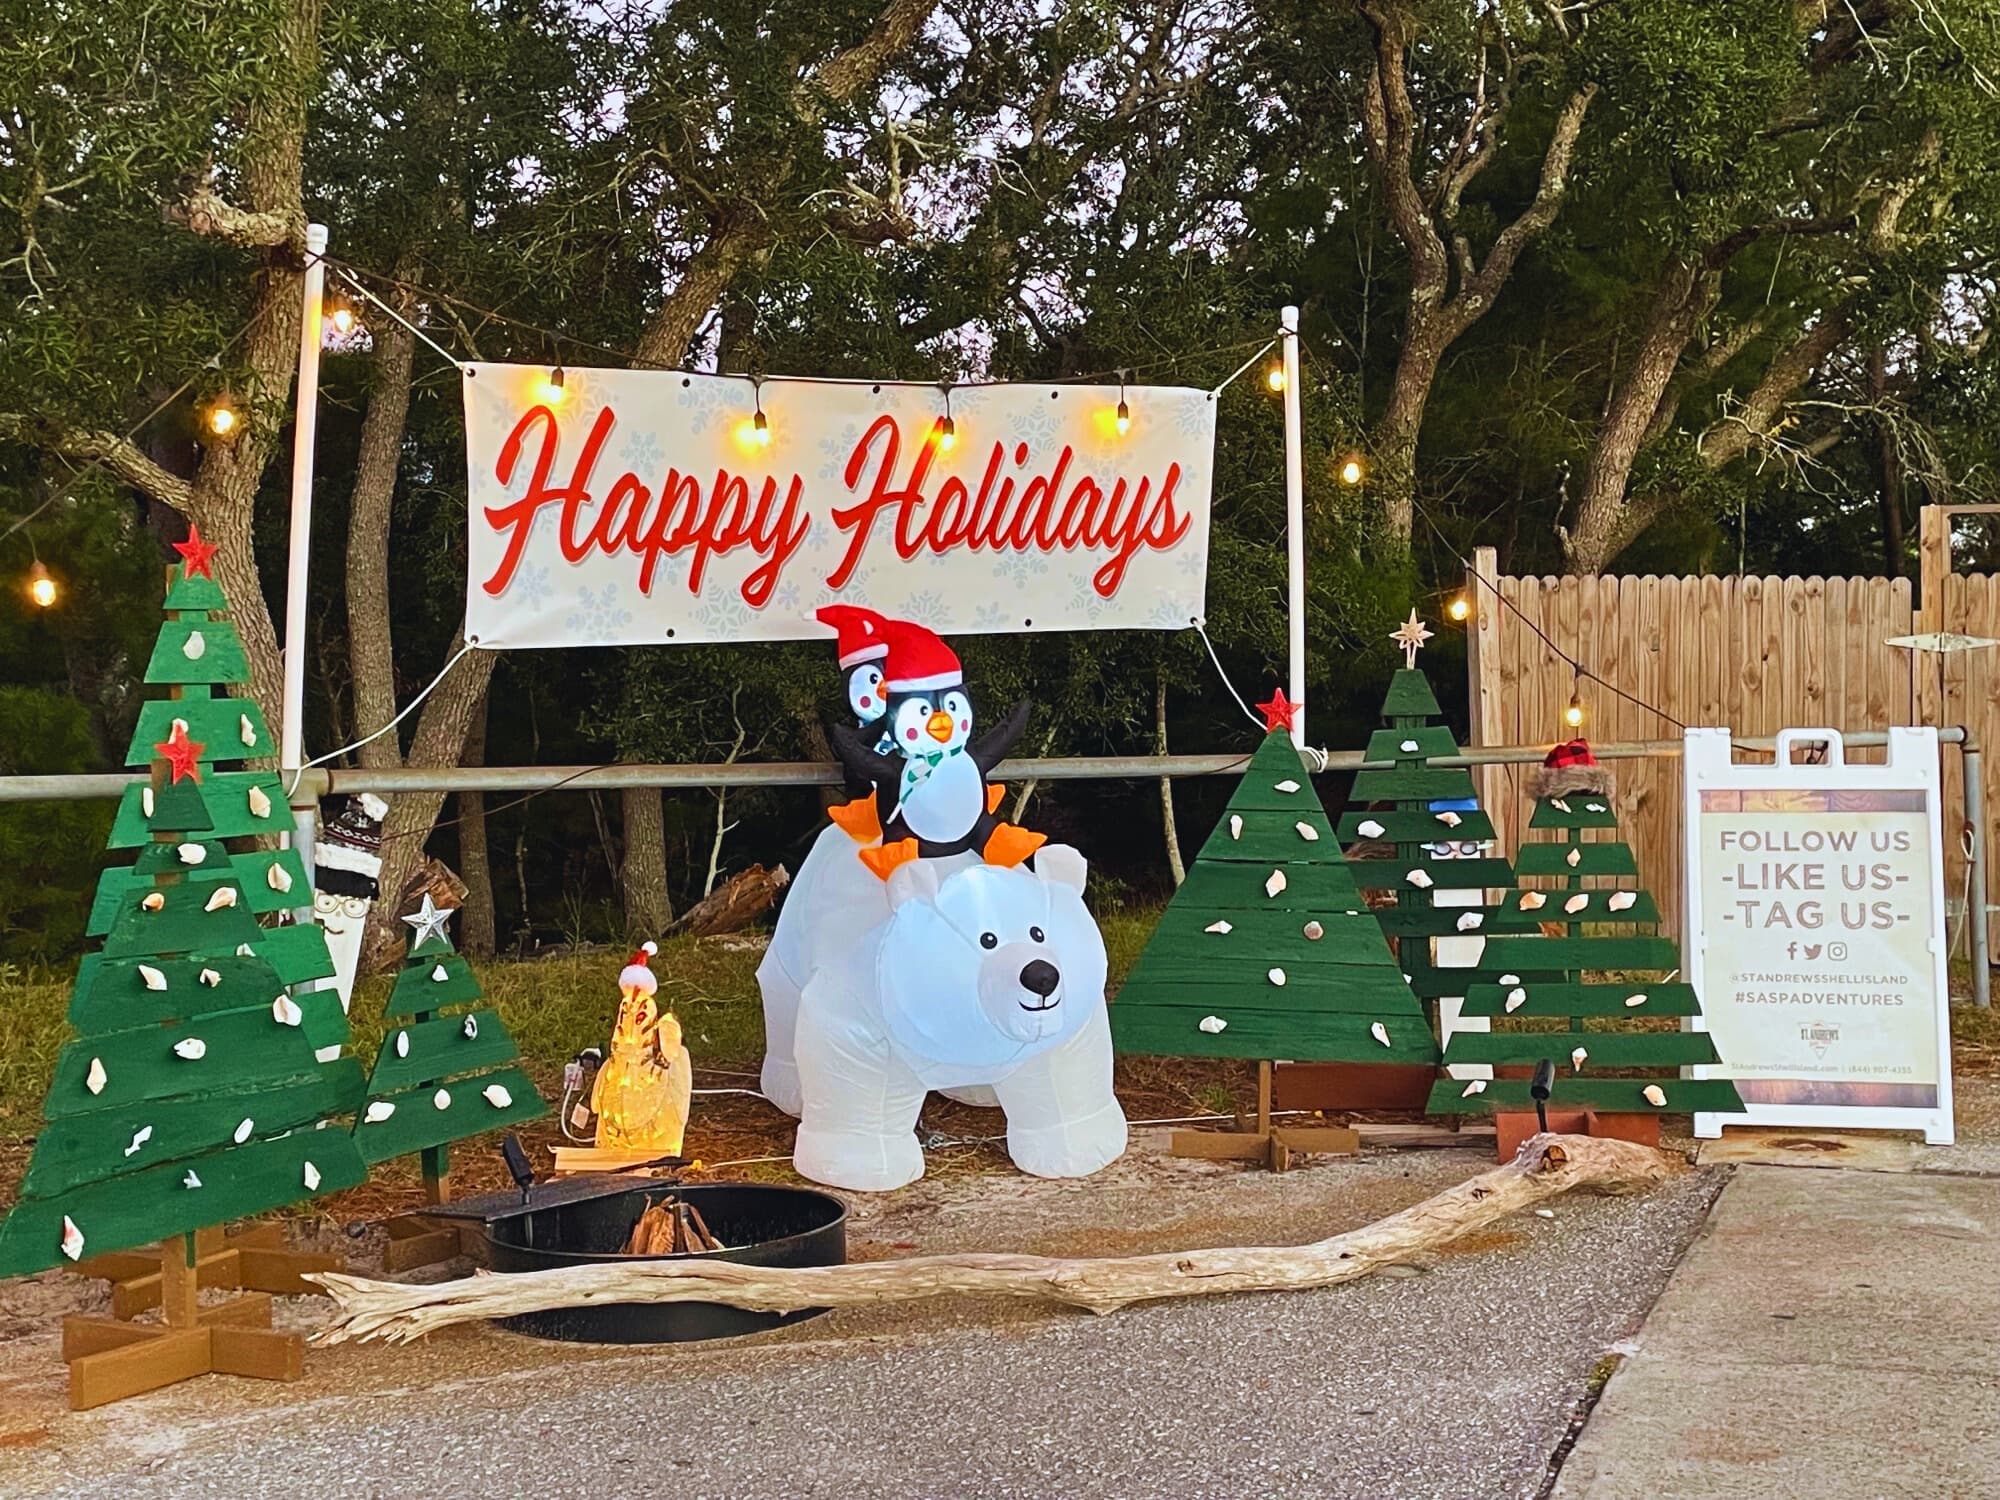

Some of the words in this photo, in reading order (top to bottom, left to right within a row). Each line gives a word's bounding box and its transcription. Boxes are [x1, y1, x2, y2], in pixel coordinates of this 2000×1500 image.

[482, 405, 810, 608] Happy
[826, 415, 1191, 599] Holidays
[1720, 831, 1857, 851] FOLLOW
[1871, 831, 1910, 851] US
[1722, 864, 1825, 890] -LIKE
[1842, 864, 1909, 890] US-
[1723, 901, 1824, 928] -TAG
[1840, 901, 1910, 929] US-
[1731, 973, 1908, 985] @STANDREWSSHELLISLAND
[1735, 992, 1904, 1006] #SASPADVENTURES
